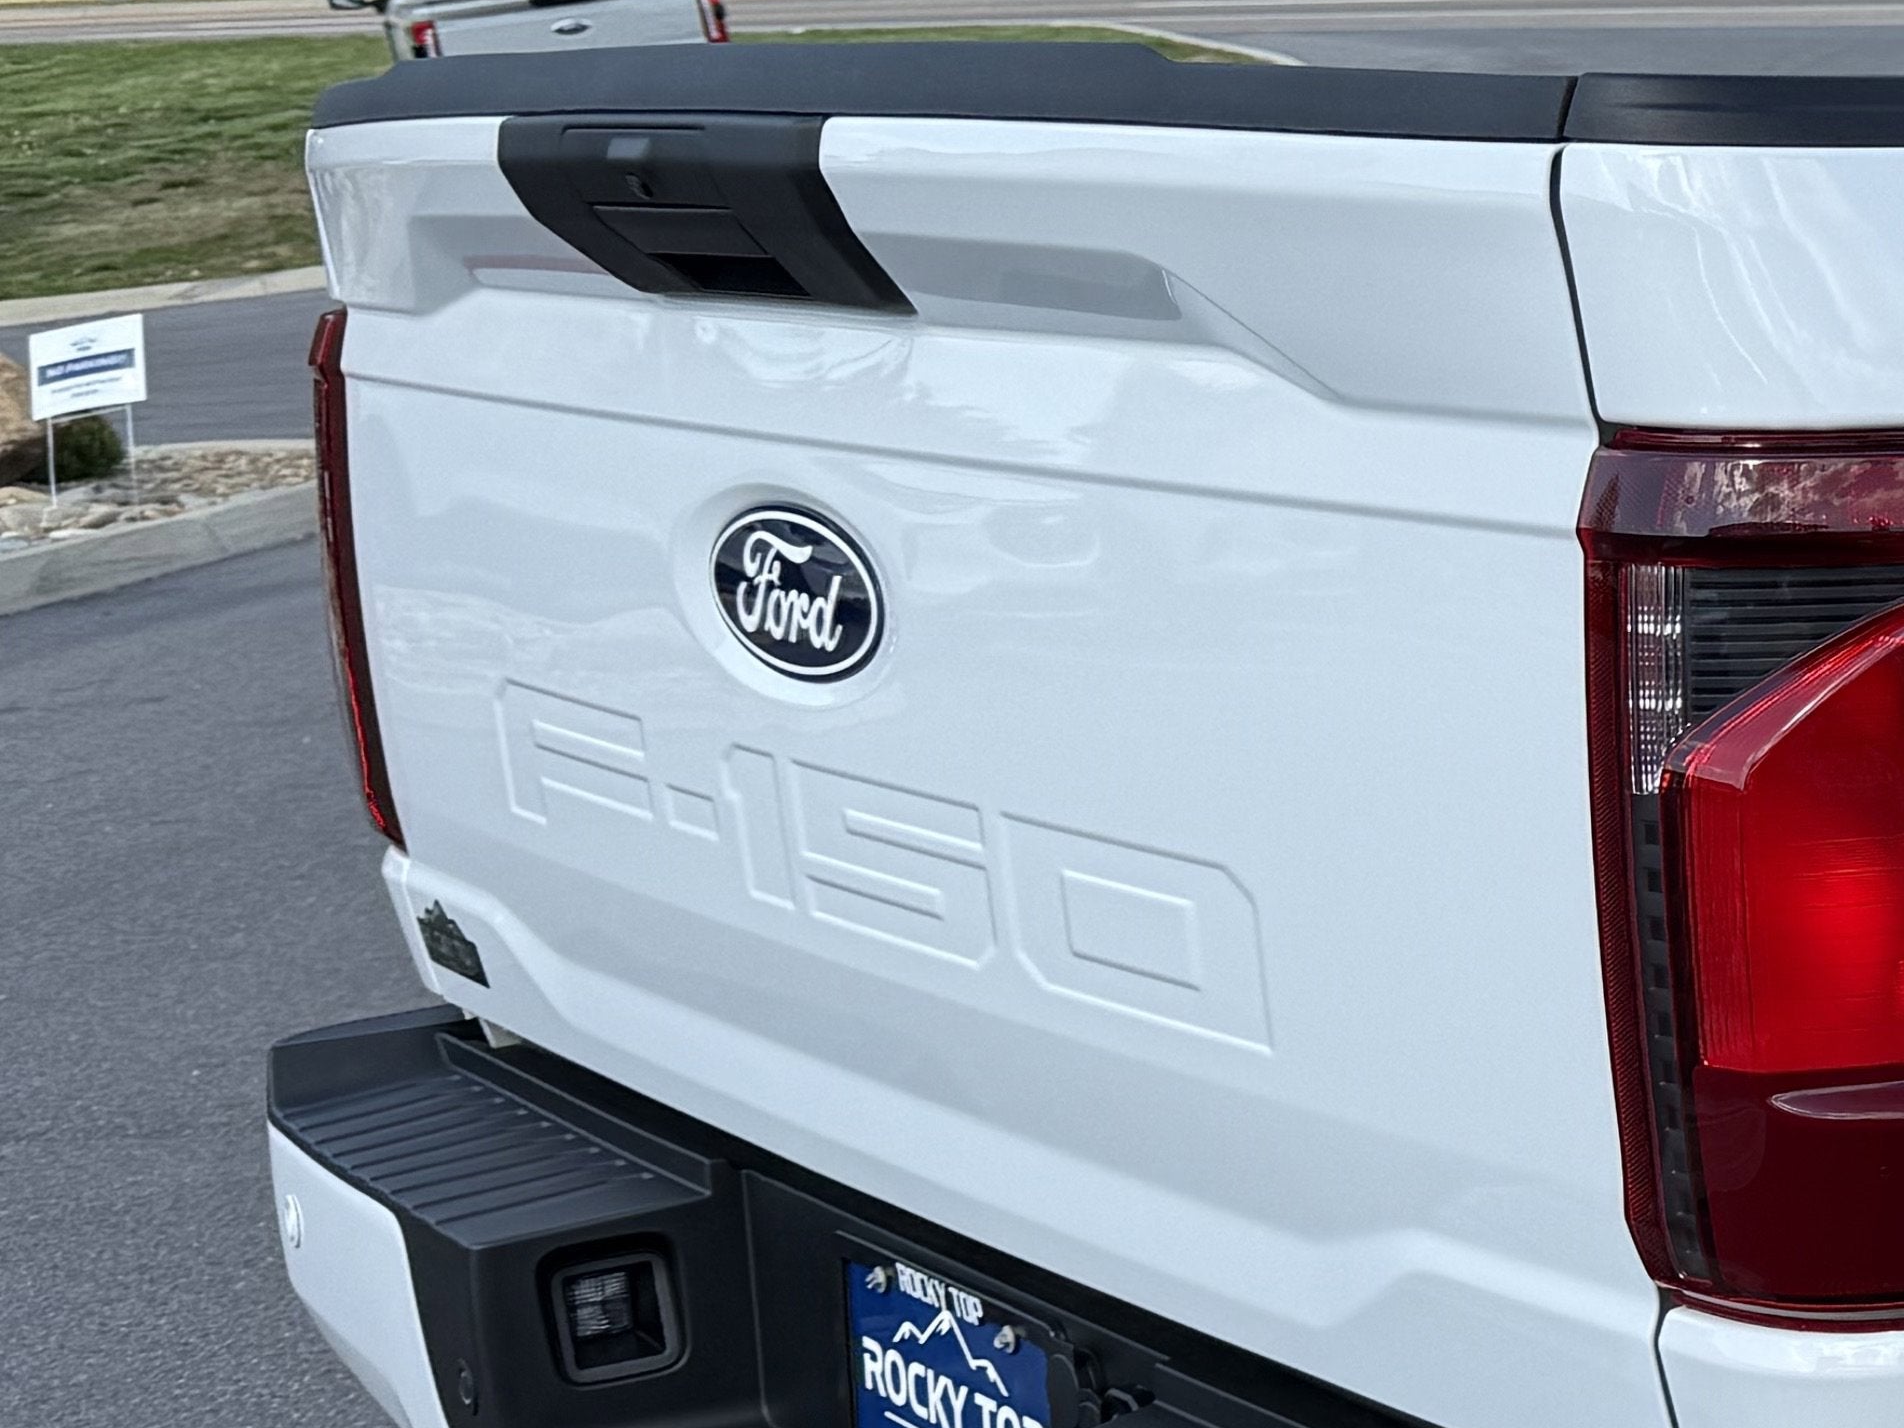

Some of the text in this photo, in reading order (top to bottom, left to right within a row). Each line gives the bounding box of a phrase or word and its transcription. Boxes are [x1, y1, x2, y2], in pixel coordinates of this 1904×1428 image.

[736, 528, 845, 654] Ford
[494, 676, 1276, 1058] F-150
[895, 1262, 984, 1326] ROCKY TOP
